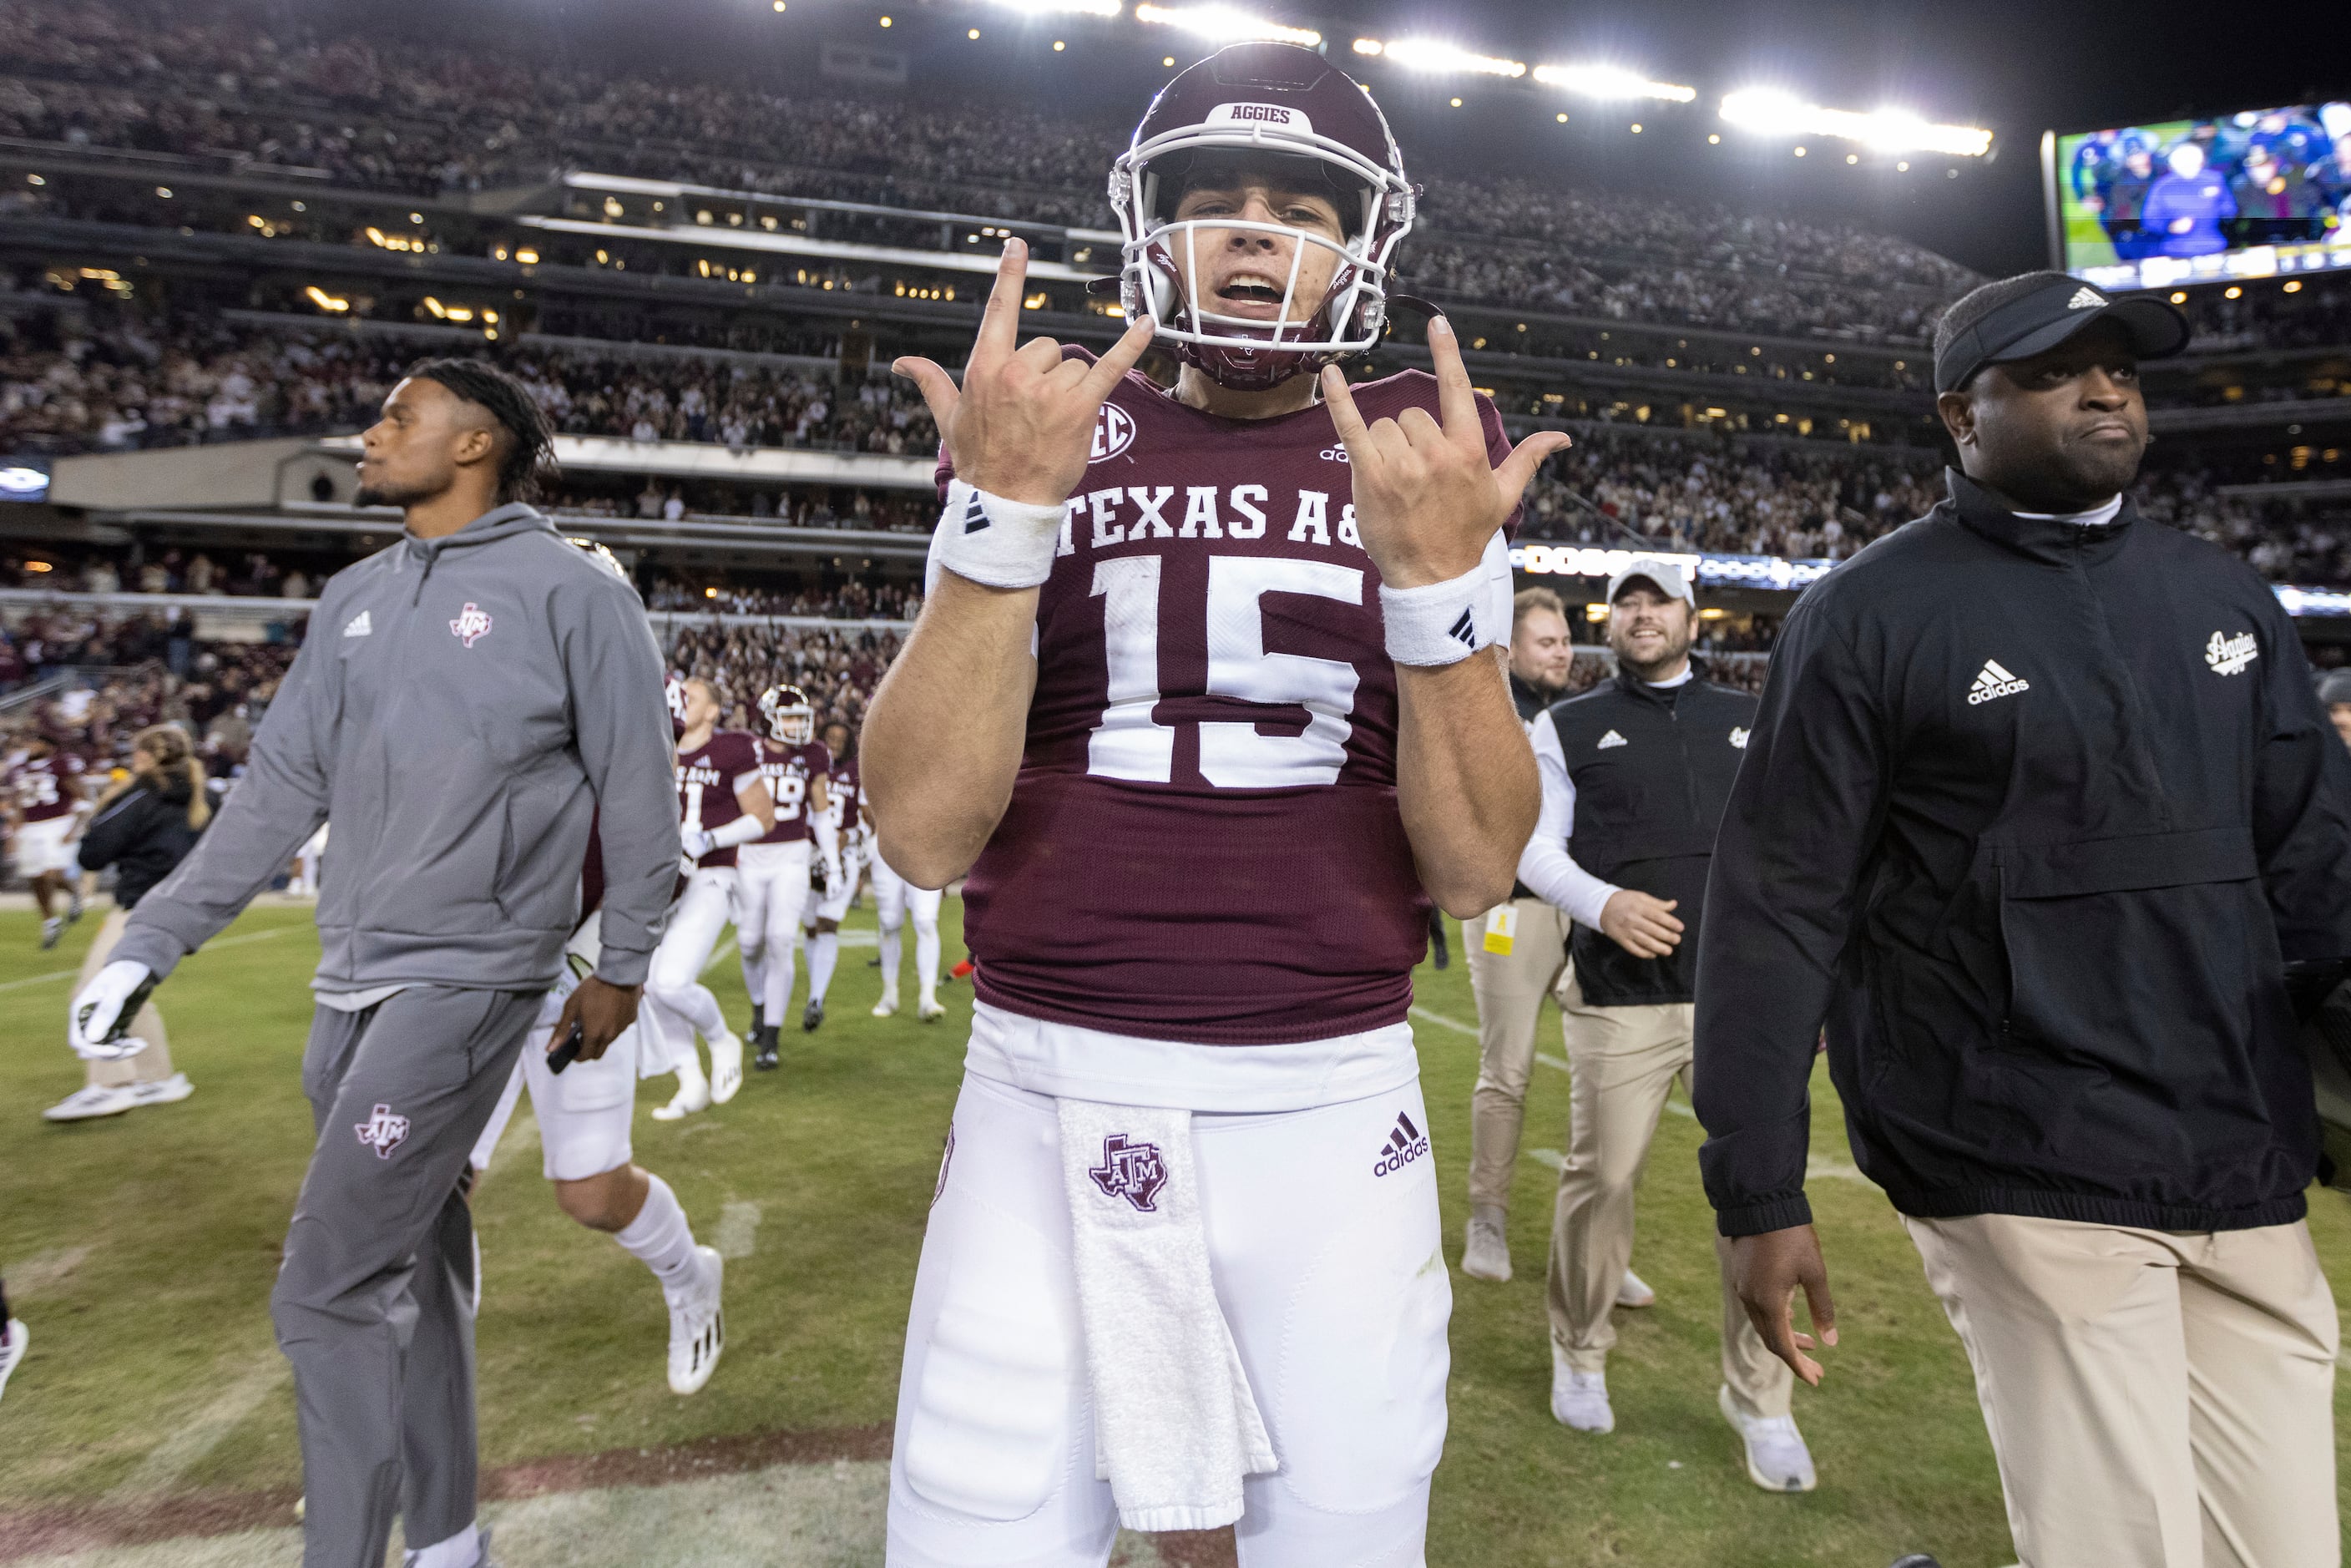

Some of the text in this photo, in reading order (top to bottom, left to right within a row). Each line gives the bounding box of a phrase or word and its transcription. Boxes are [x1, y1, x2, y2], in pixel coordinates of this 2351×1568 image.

[1231, 105, 1291, 124] AGGIES
[1090, 406, 1129, 458] EC
[1056, 484, 1367, 557] TEXAS A&
[1086, 554, 1364, 788] 15
[1967, 679, 2030, 706] adidas
[1373, 1136, 1428, 1177] adidas
